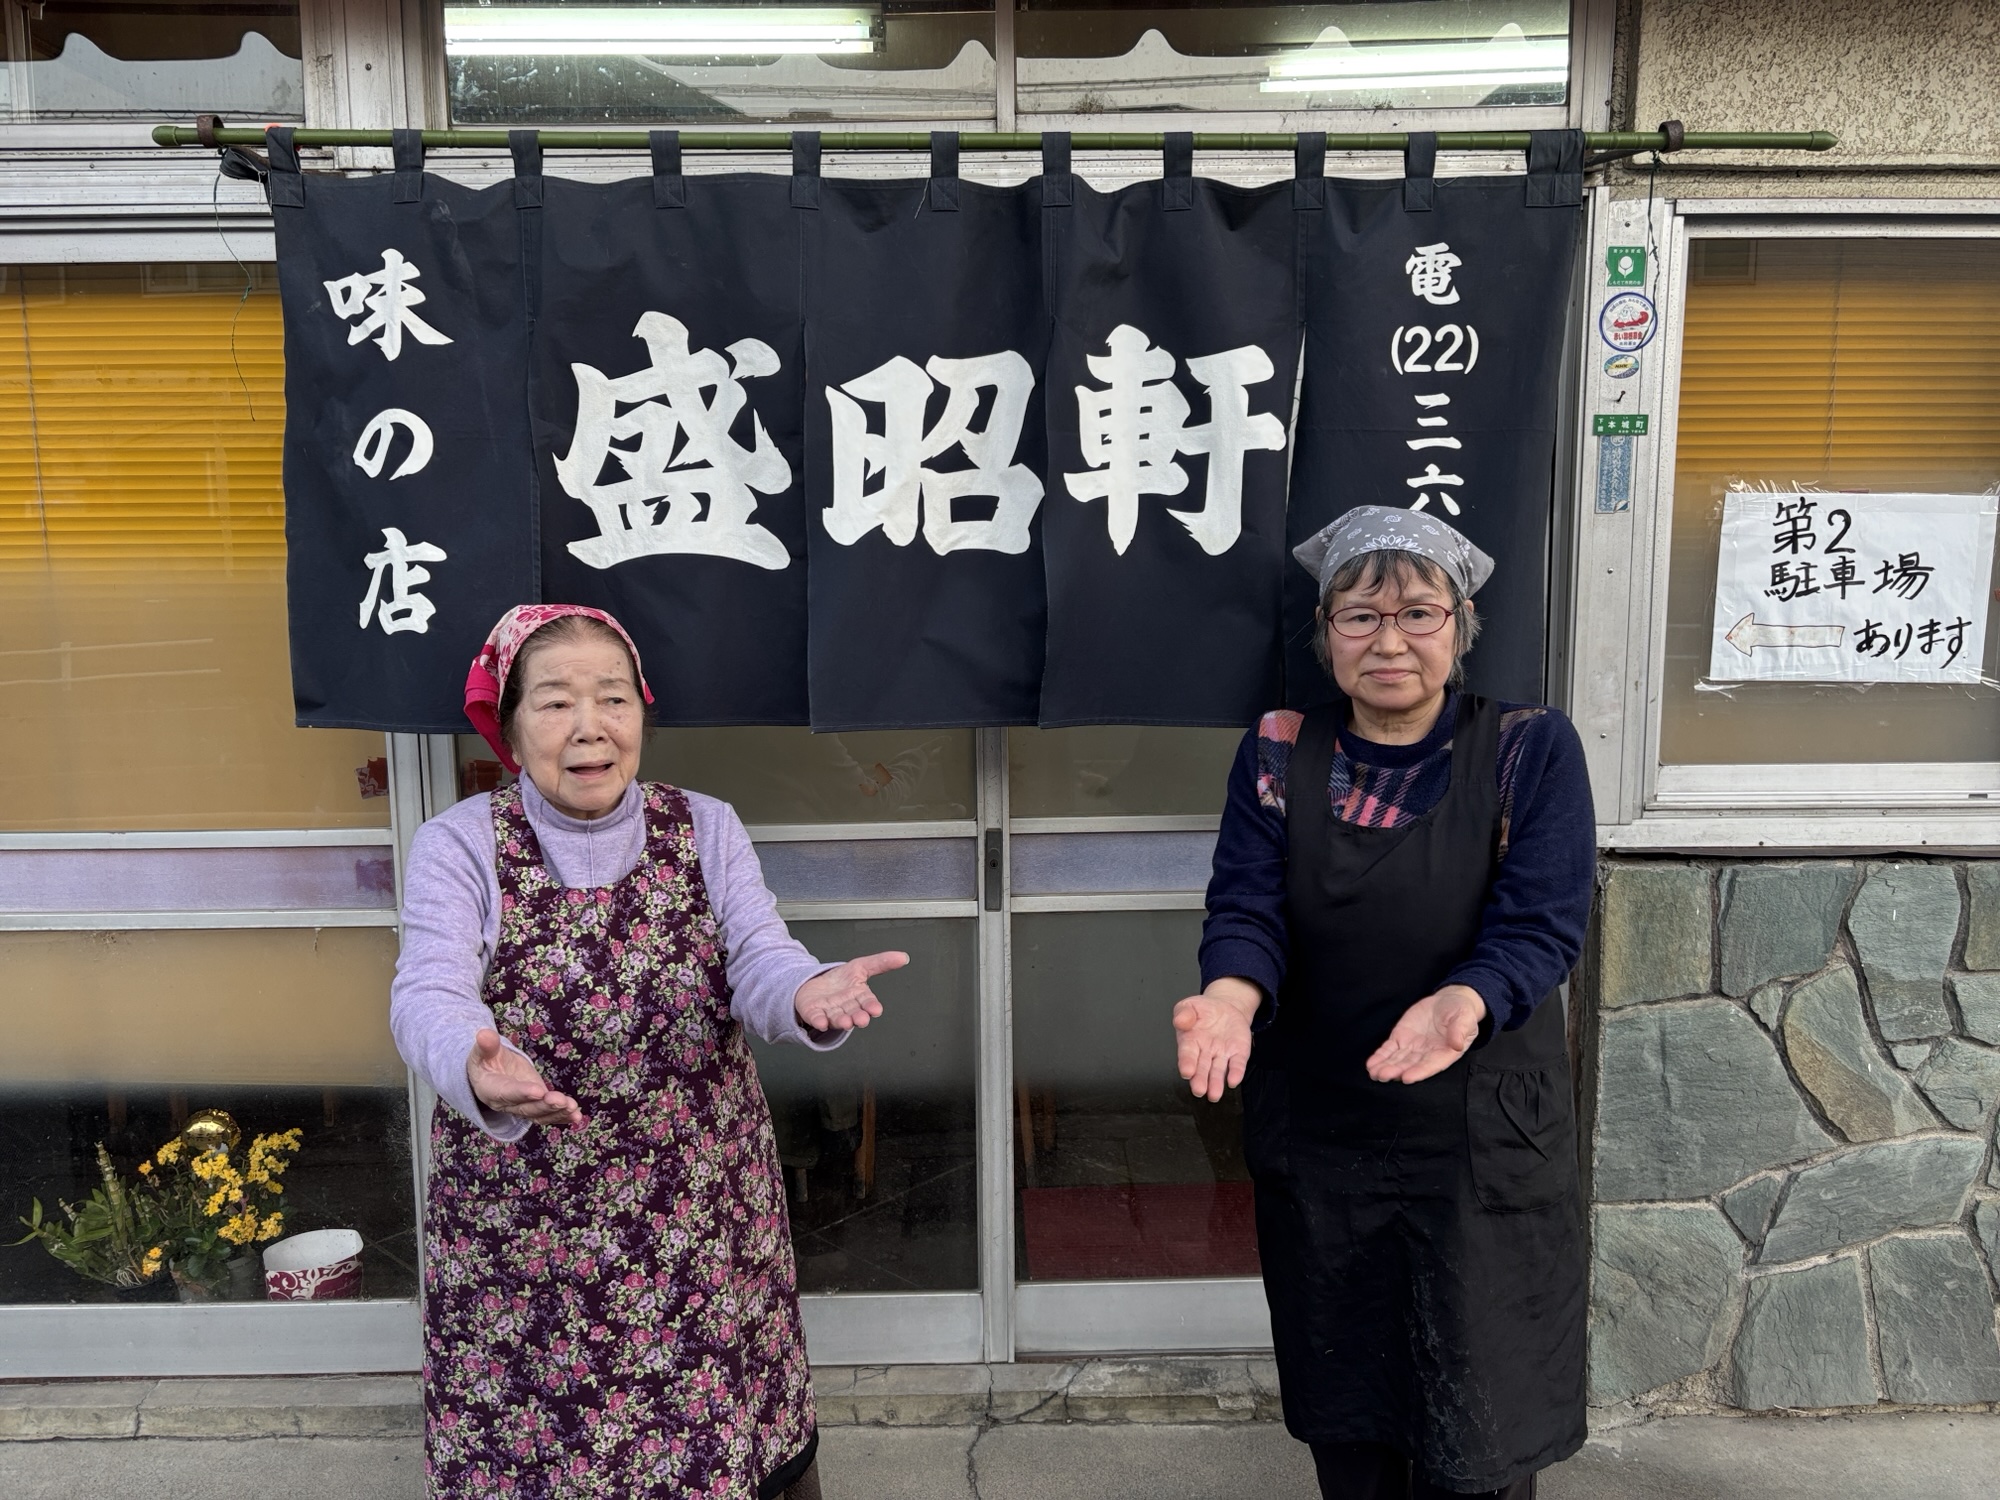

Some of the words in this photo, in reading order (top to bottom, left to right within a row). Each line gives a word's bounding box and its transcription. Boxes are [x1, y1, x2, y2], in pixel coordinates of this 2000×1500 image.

[323, 248, 454, 635] 味の店
[551, 310, 1287, 570] 盛昭軒
[1607, 420, 1645, 429] 本城町
[1772, 496, 1856, 555] 第2
[1764, 552, 1936, 603] 駐車場
[1853, 615, 1973, 670] あります
